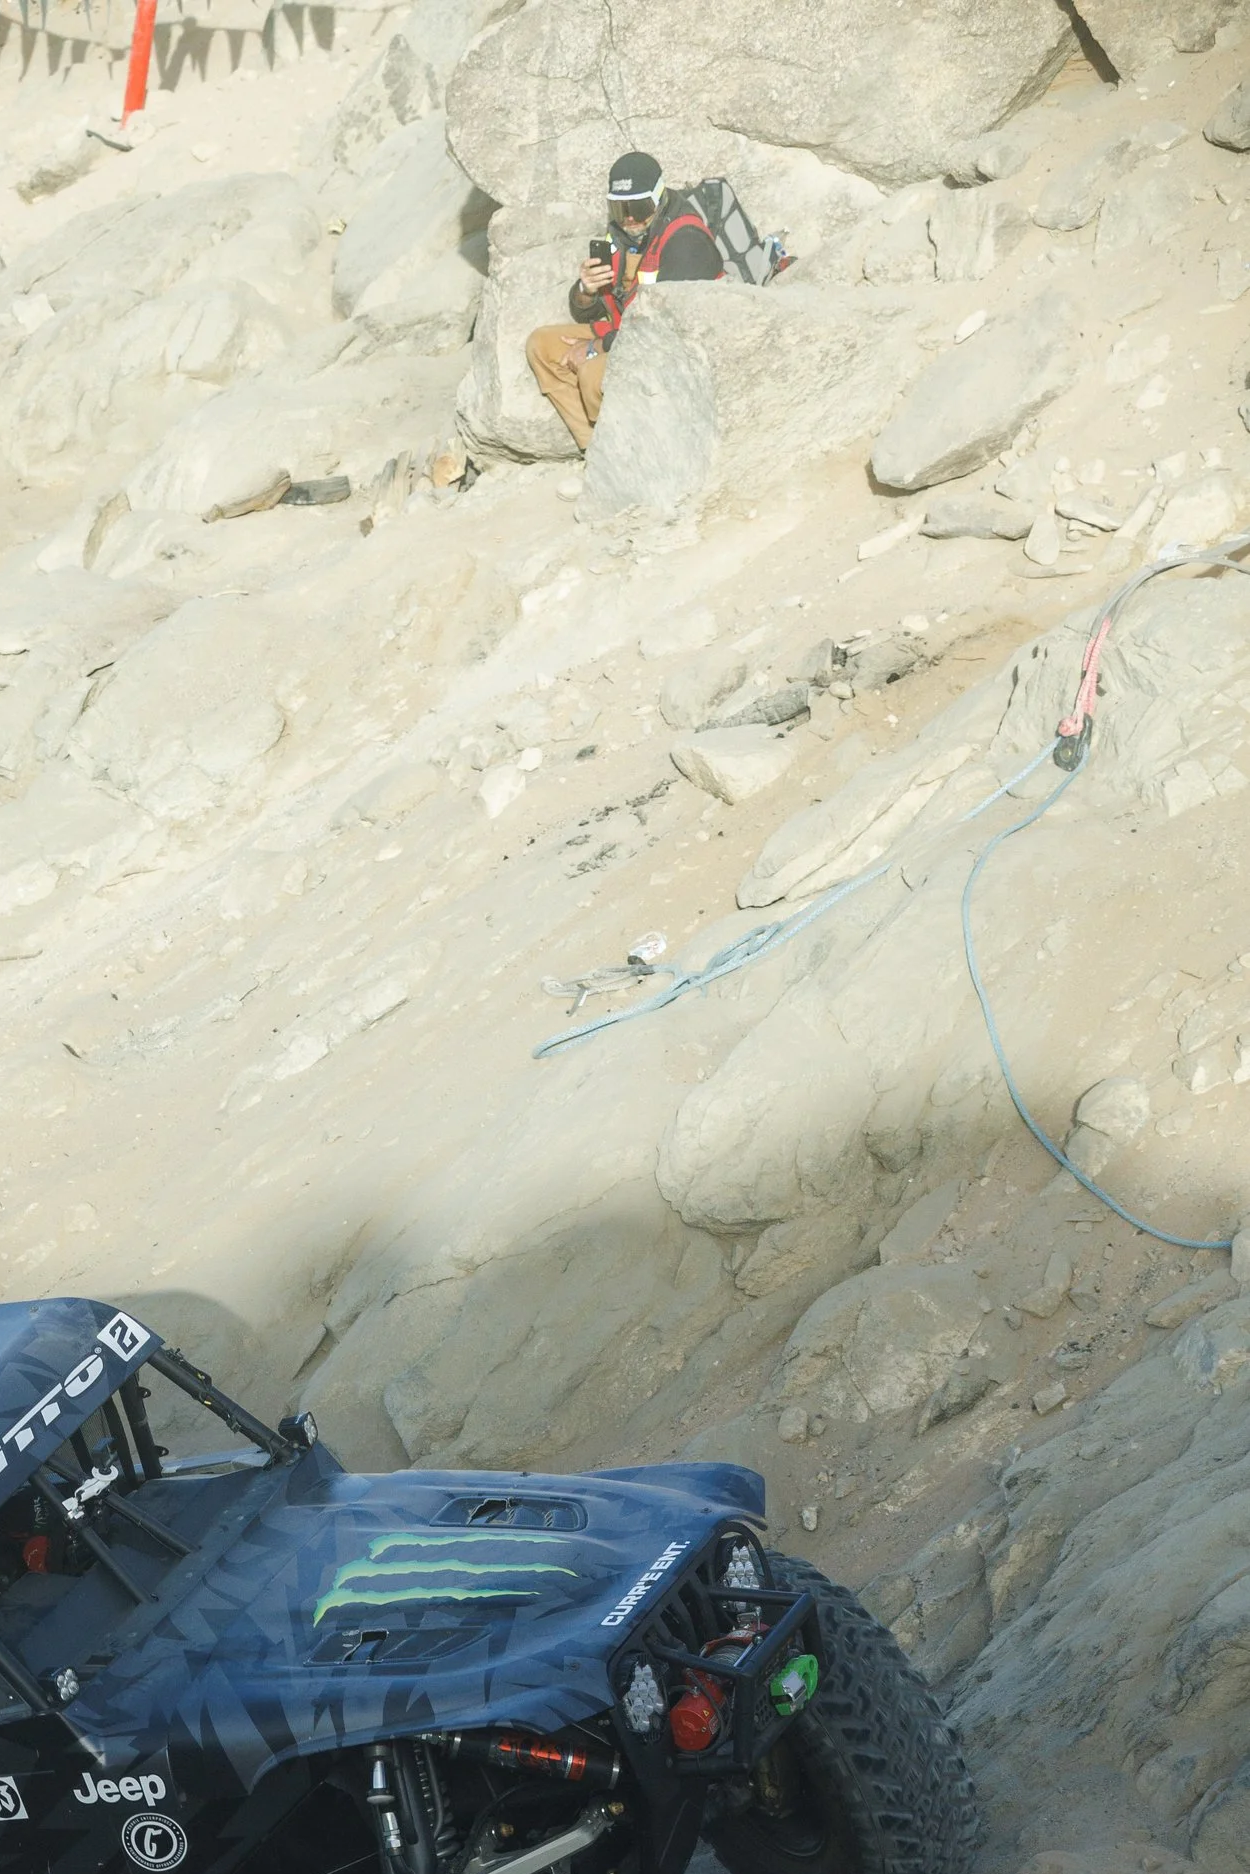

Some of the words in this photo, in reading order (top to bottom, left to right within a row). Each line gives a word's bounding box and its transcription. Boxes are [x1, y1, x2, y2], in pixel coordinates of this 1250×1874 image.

[109, 1318, 140, 1356] 2
[649, 1540, 691, 1570] ENT.
[73, 1772, 166, 1807] Jeep
